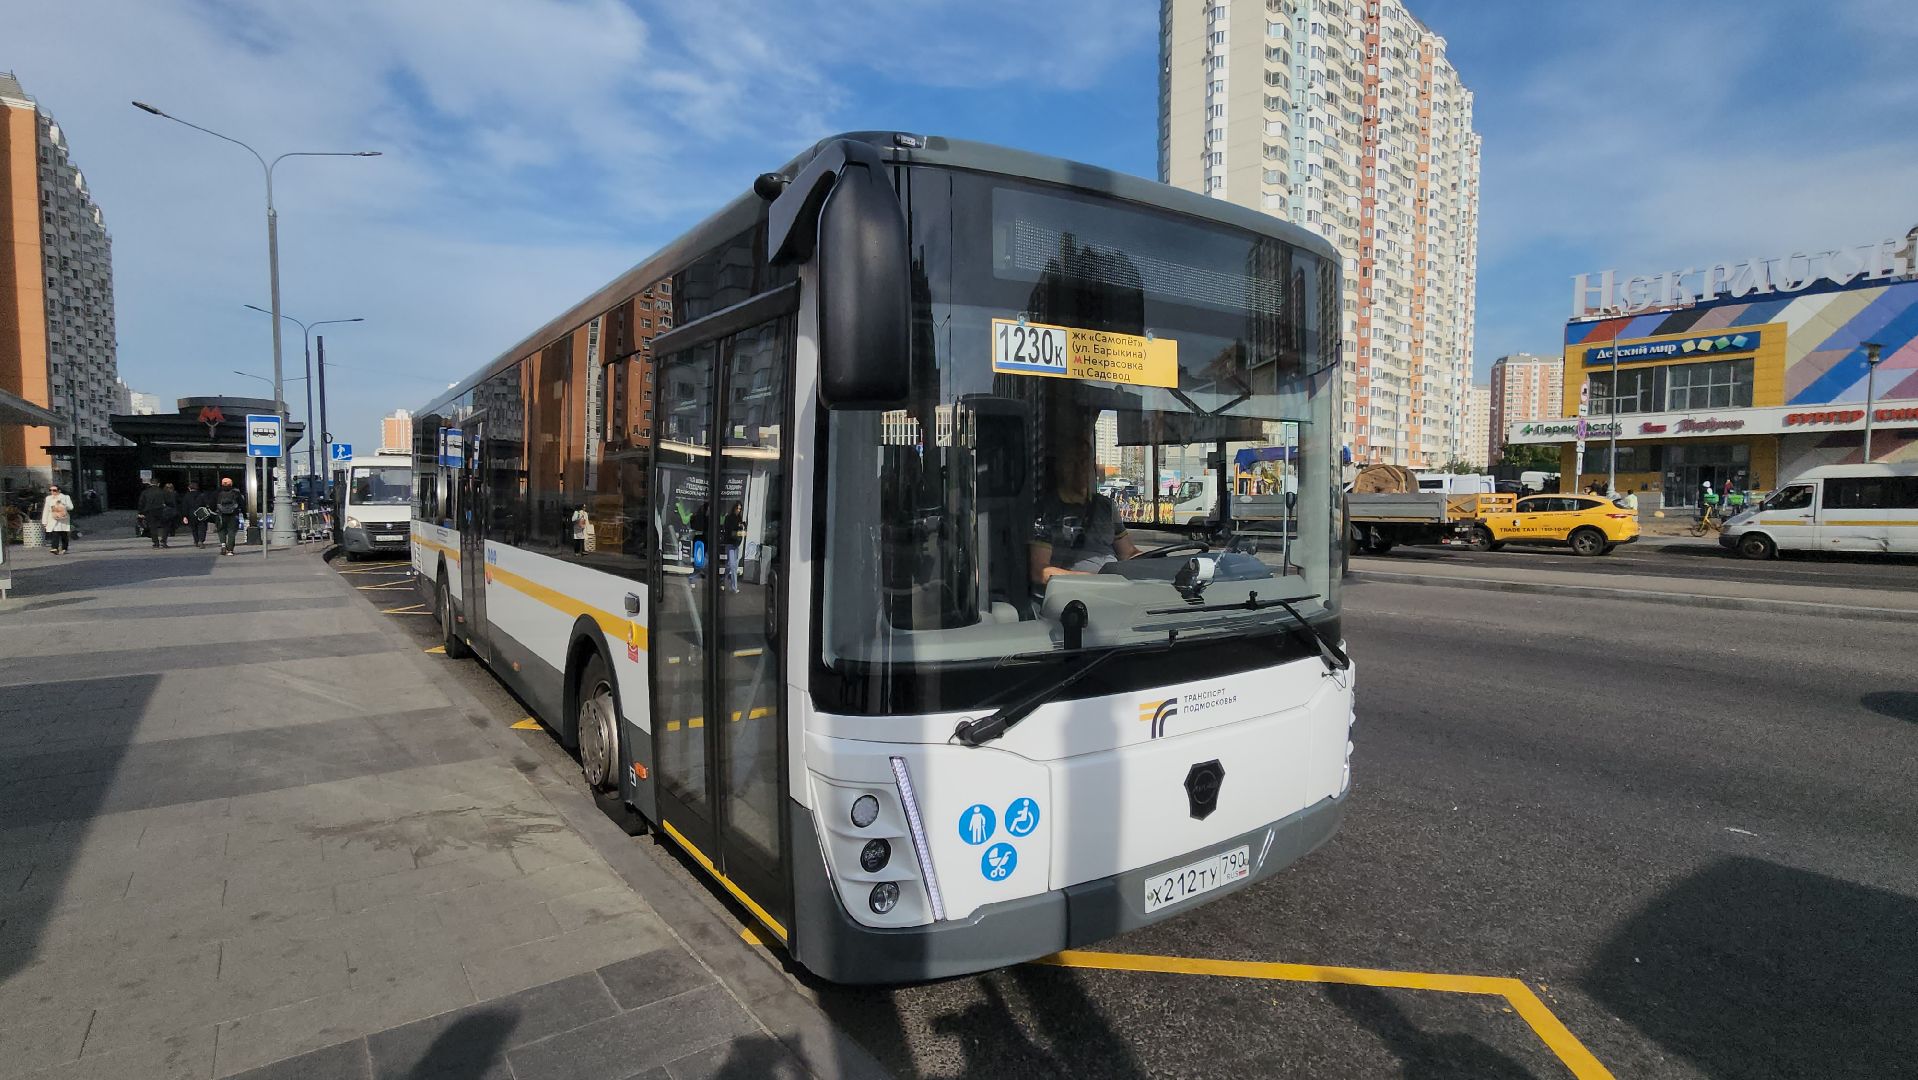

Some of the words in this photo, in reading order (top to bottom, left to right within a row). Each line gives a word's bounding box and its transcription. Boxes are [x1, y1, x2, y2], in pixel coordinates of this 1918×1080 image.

[1569, 234, 1918, 319] НЕКРАСОВ
[1072, 331, 1087, 341] жк
[1072, 344, 1090, 354] (ул.
[1094, 345, 1147, 360] Барыкина)
[1596, 345, 1648, 360] Деский
[1649, 343, 1677, 355] мир
[1087, 368, 1131, 382] Садовод
[1786, 410, 1866, 426] БУРГЕР
[1184, 688, 1226, 702] ТРАНСПОРТ
[1183, 695, 1237, 713] ПОДМОСКОВЬЯ
[1222, 851, 1245, 873] 790
[1226, 871, 1240, 879] RUS
